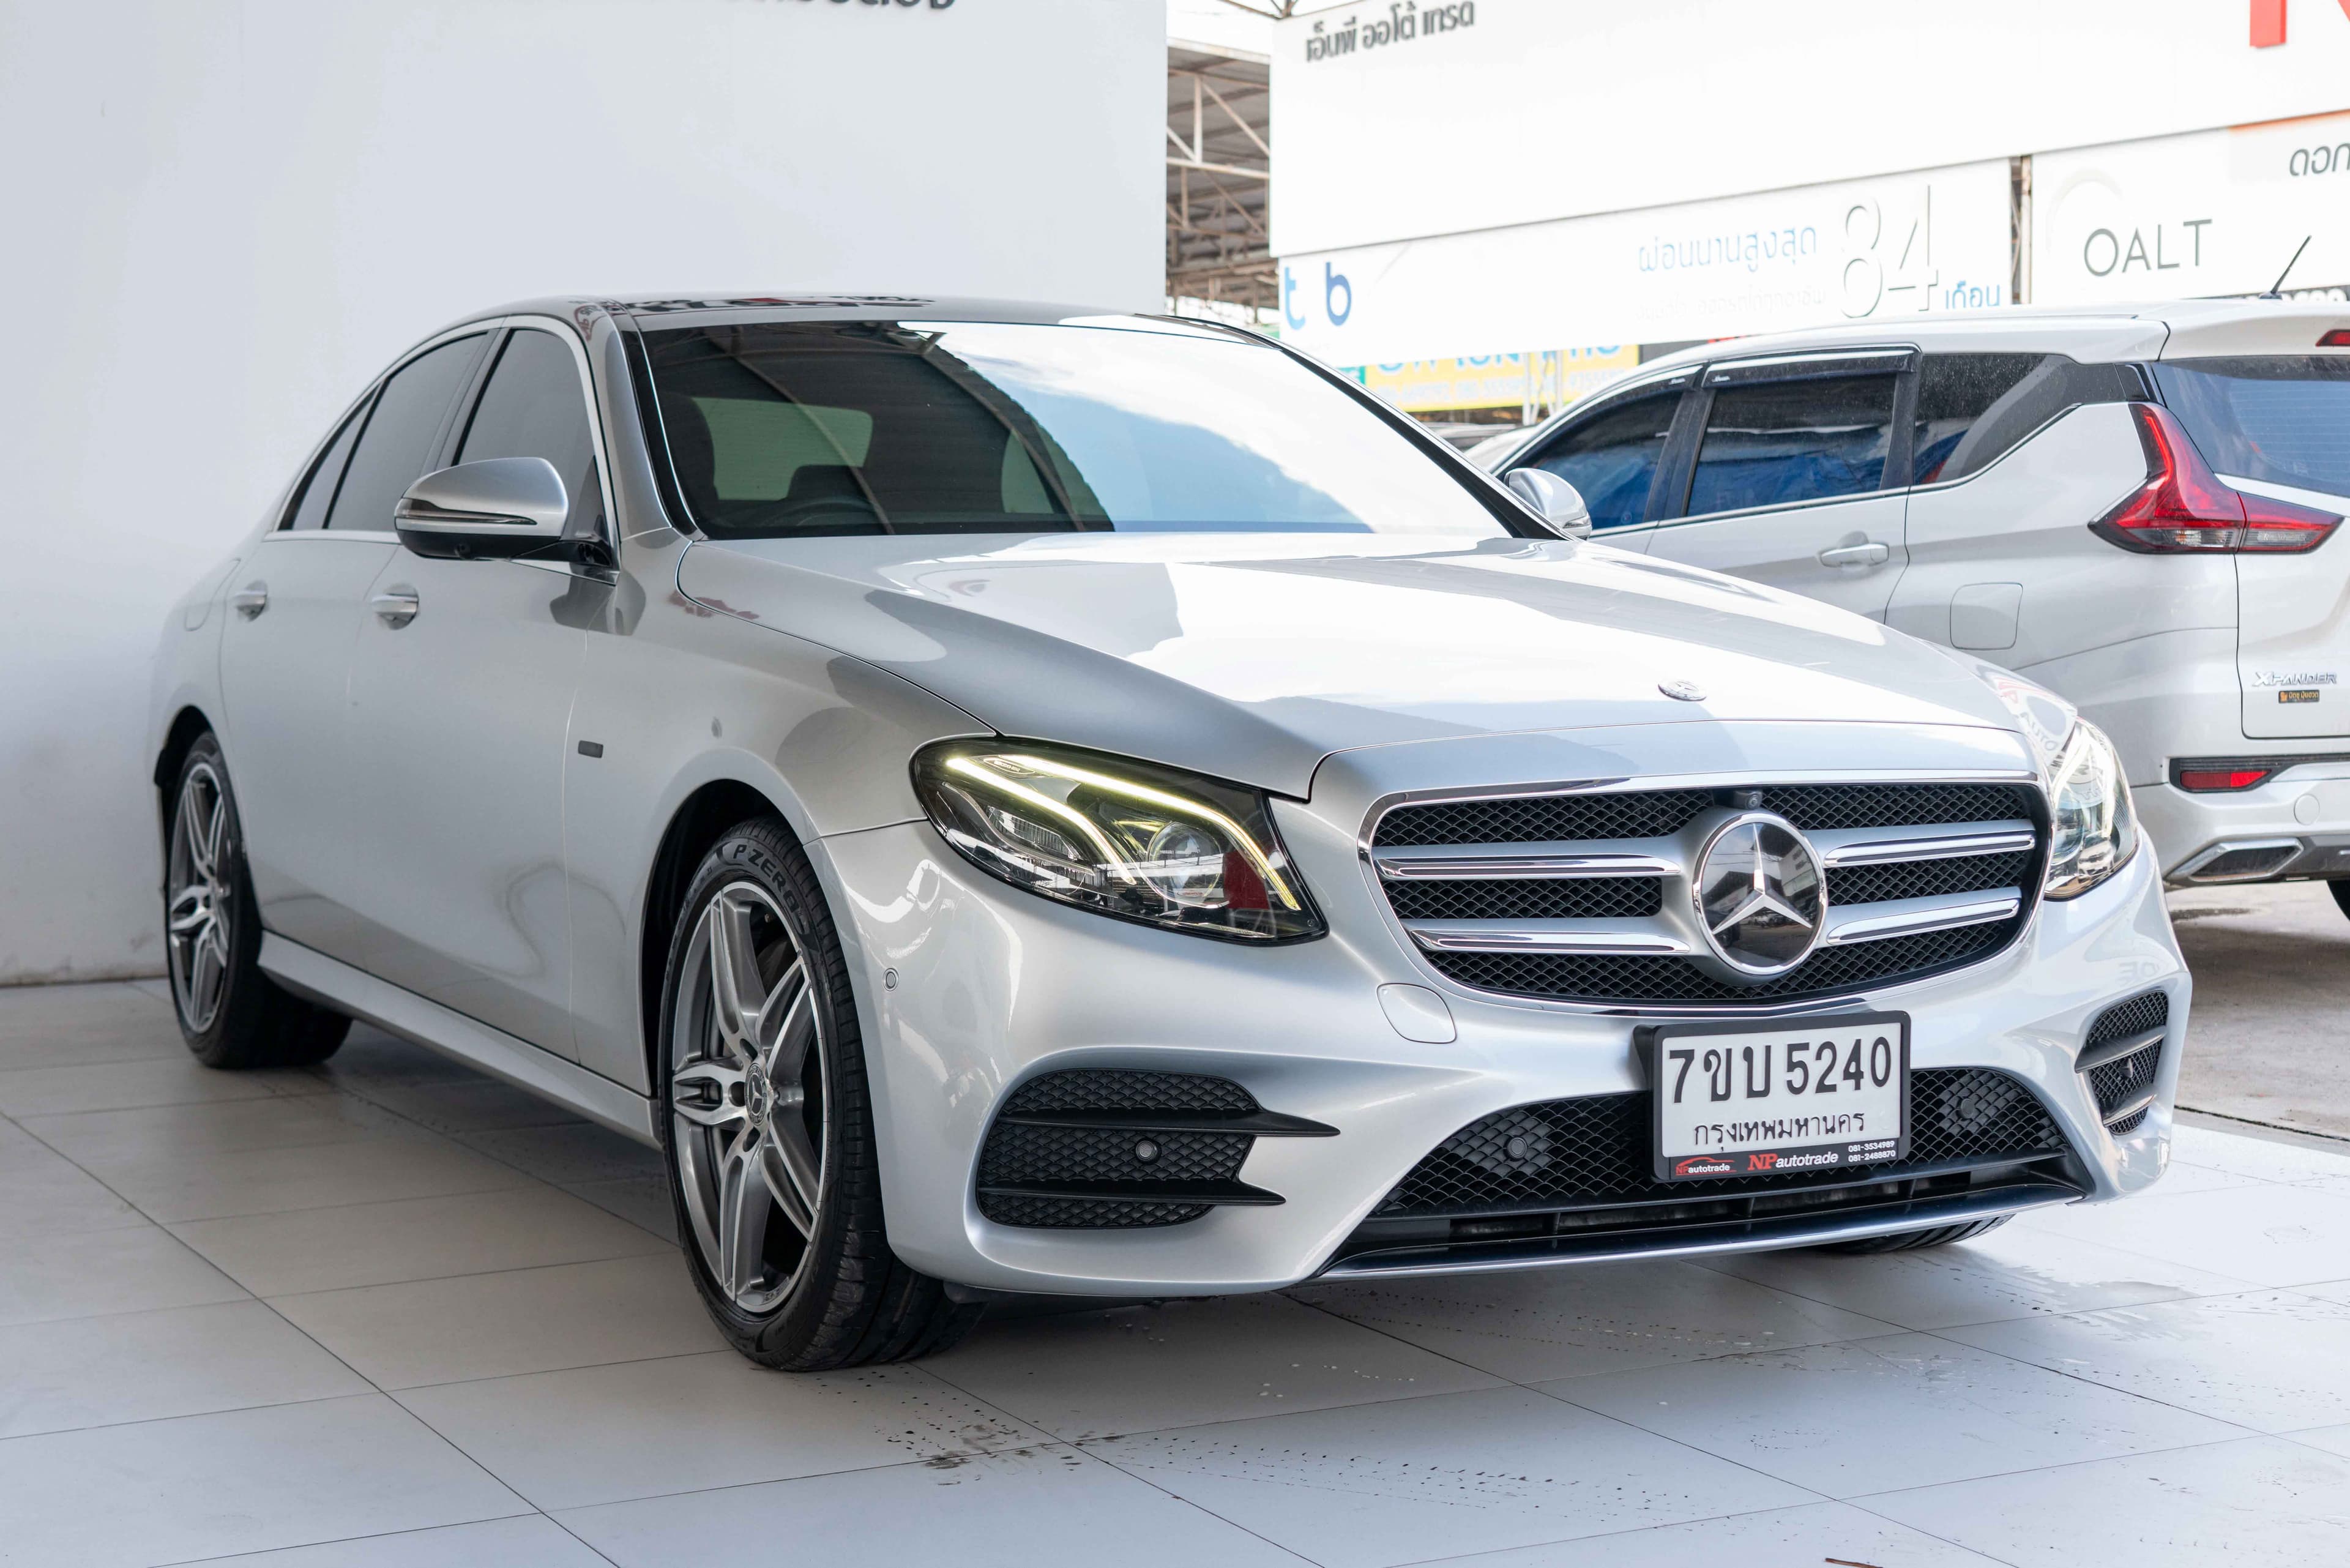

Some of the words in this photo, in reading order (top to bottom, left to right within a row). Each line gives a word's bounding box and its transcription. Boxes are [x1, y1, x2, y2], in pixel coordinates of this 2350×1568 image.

[1362, 1, 1417, 49] ออโต้
[1638, 226, 1818, 273] ผ่อนนานสูงสุด
[1841, 184, 1939, 319] 84
[2252, 671, 2337, 687] XPANDER
[748, 848, 800, 913] ZERO
[1668, 1044, 1772, 1104] 7ขบ
[1786, 1036, 1892, 1096] 5240
[1694, 1112, 1865, 1151] กรุงเทพมหานคร
